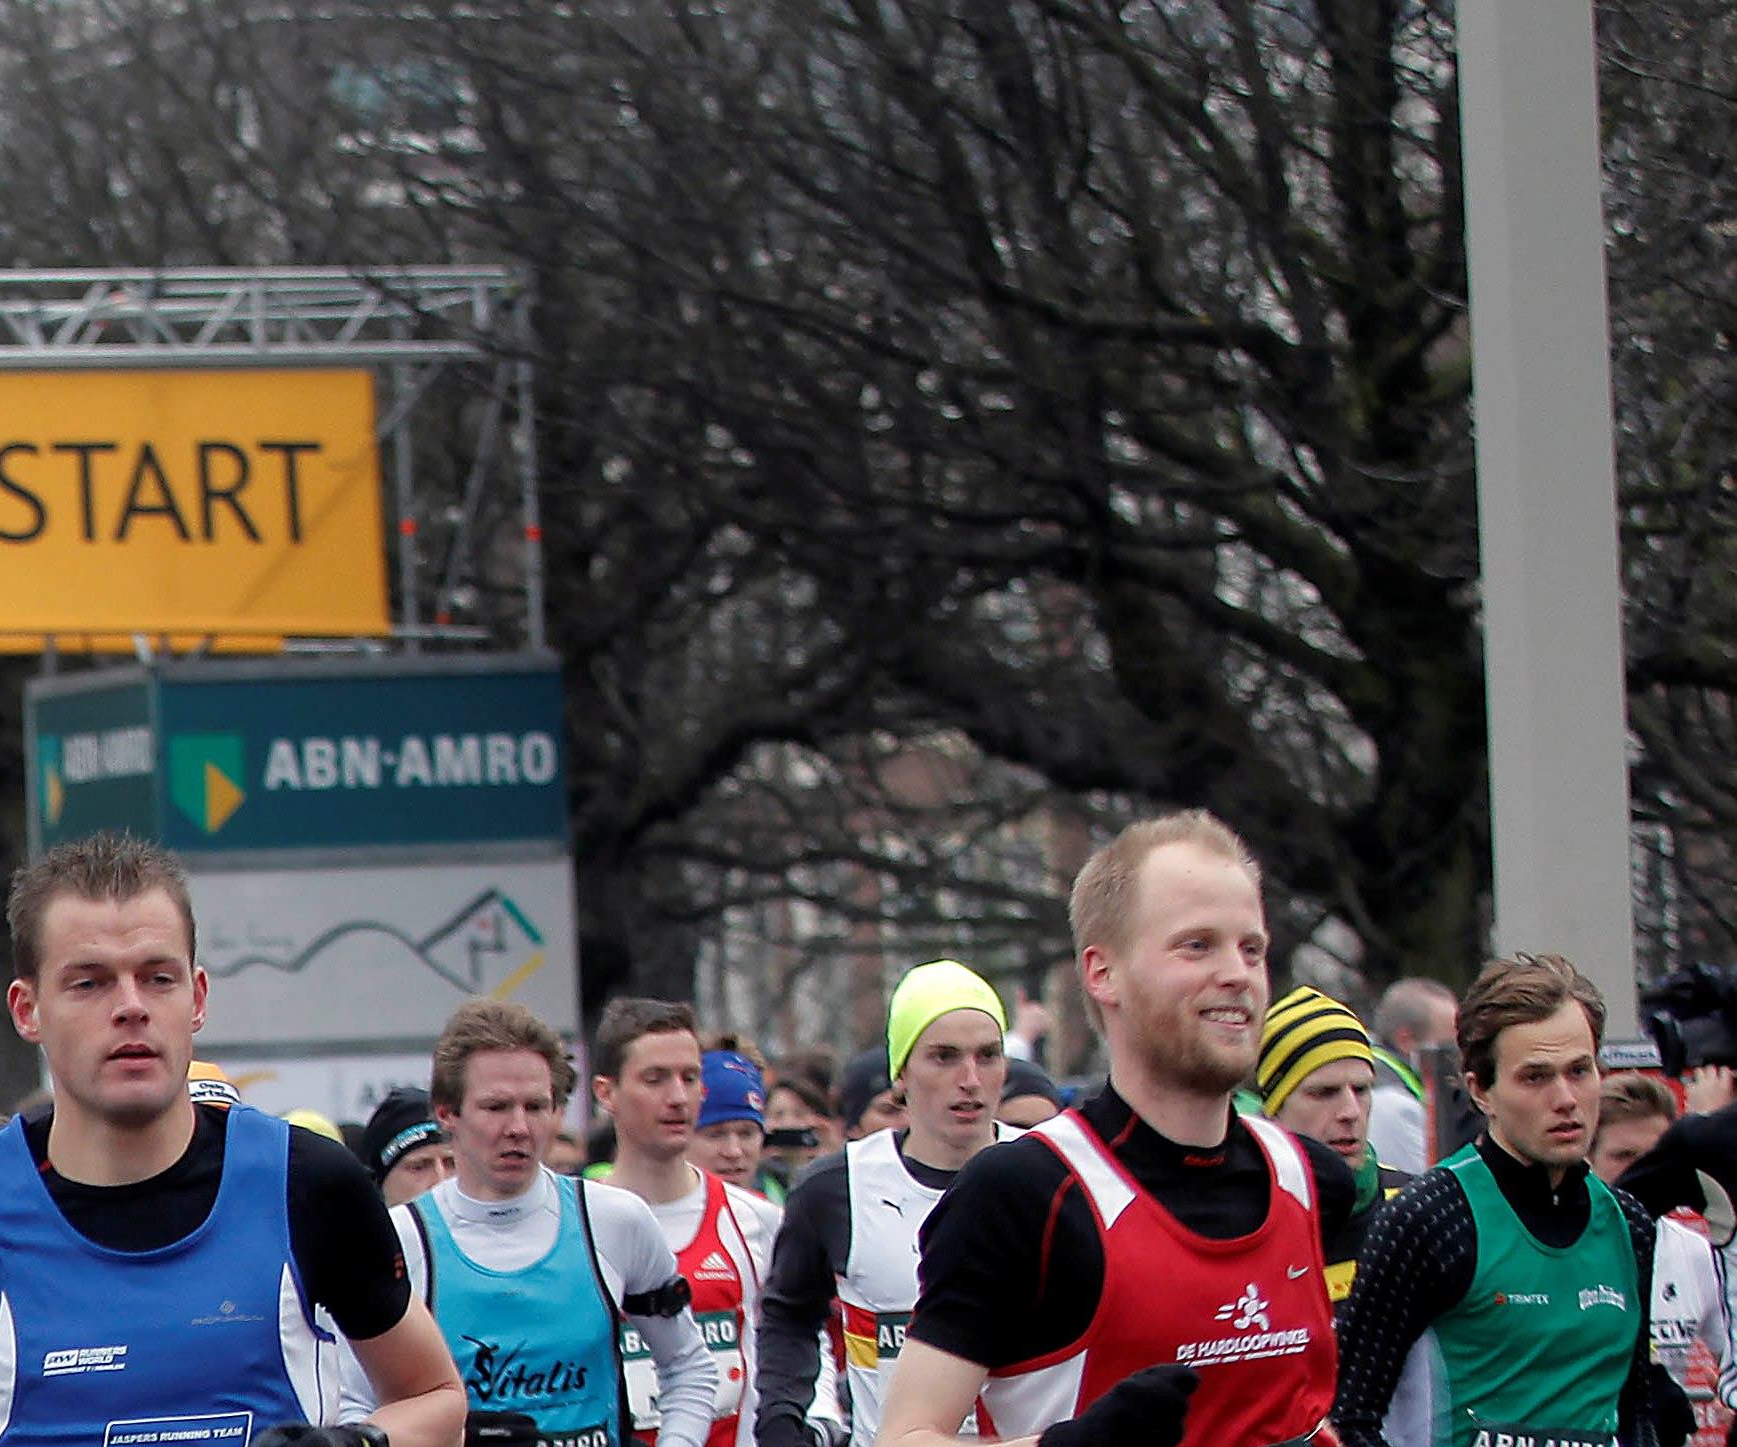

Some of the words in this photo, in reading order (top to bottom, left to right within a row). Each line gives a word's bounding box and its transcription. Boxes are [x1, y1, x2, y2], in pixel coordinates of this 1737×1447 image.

[697, 1320, 734, 1344] RO
[879, 1324, 907, 1349] AB
[212, 1426, 244, 1439] TEAM
